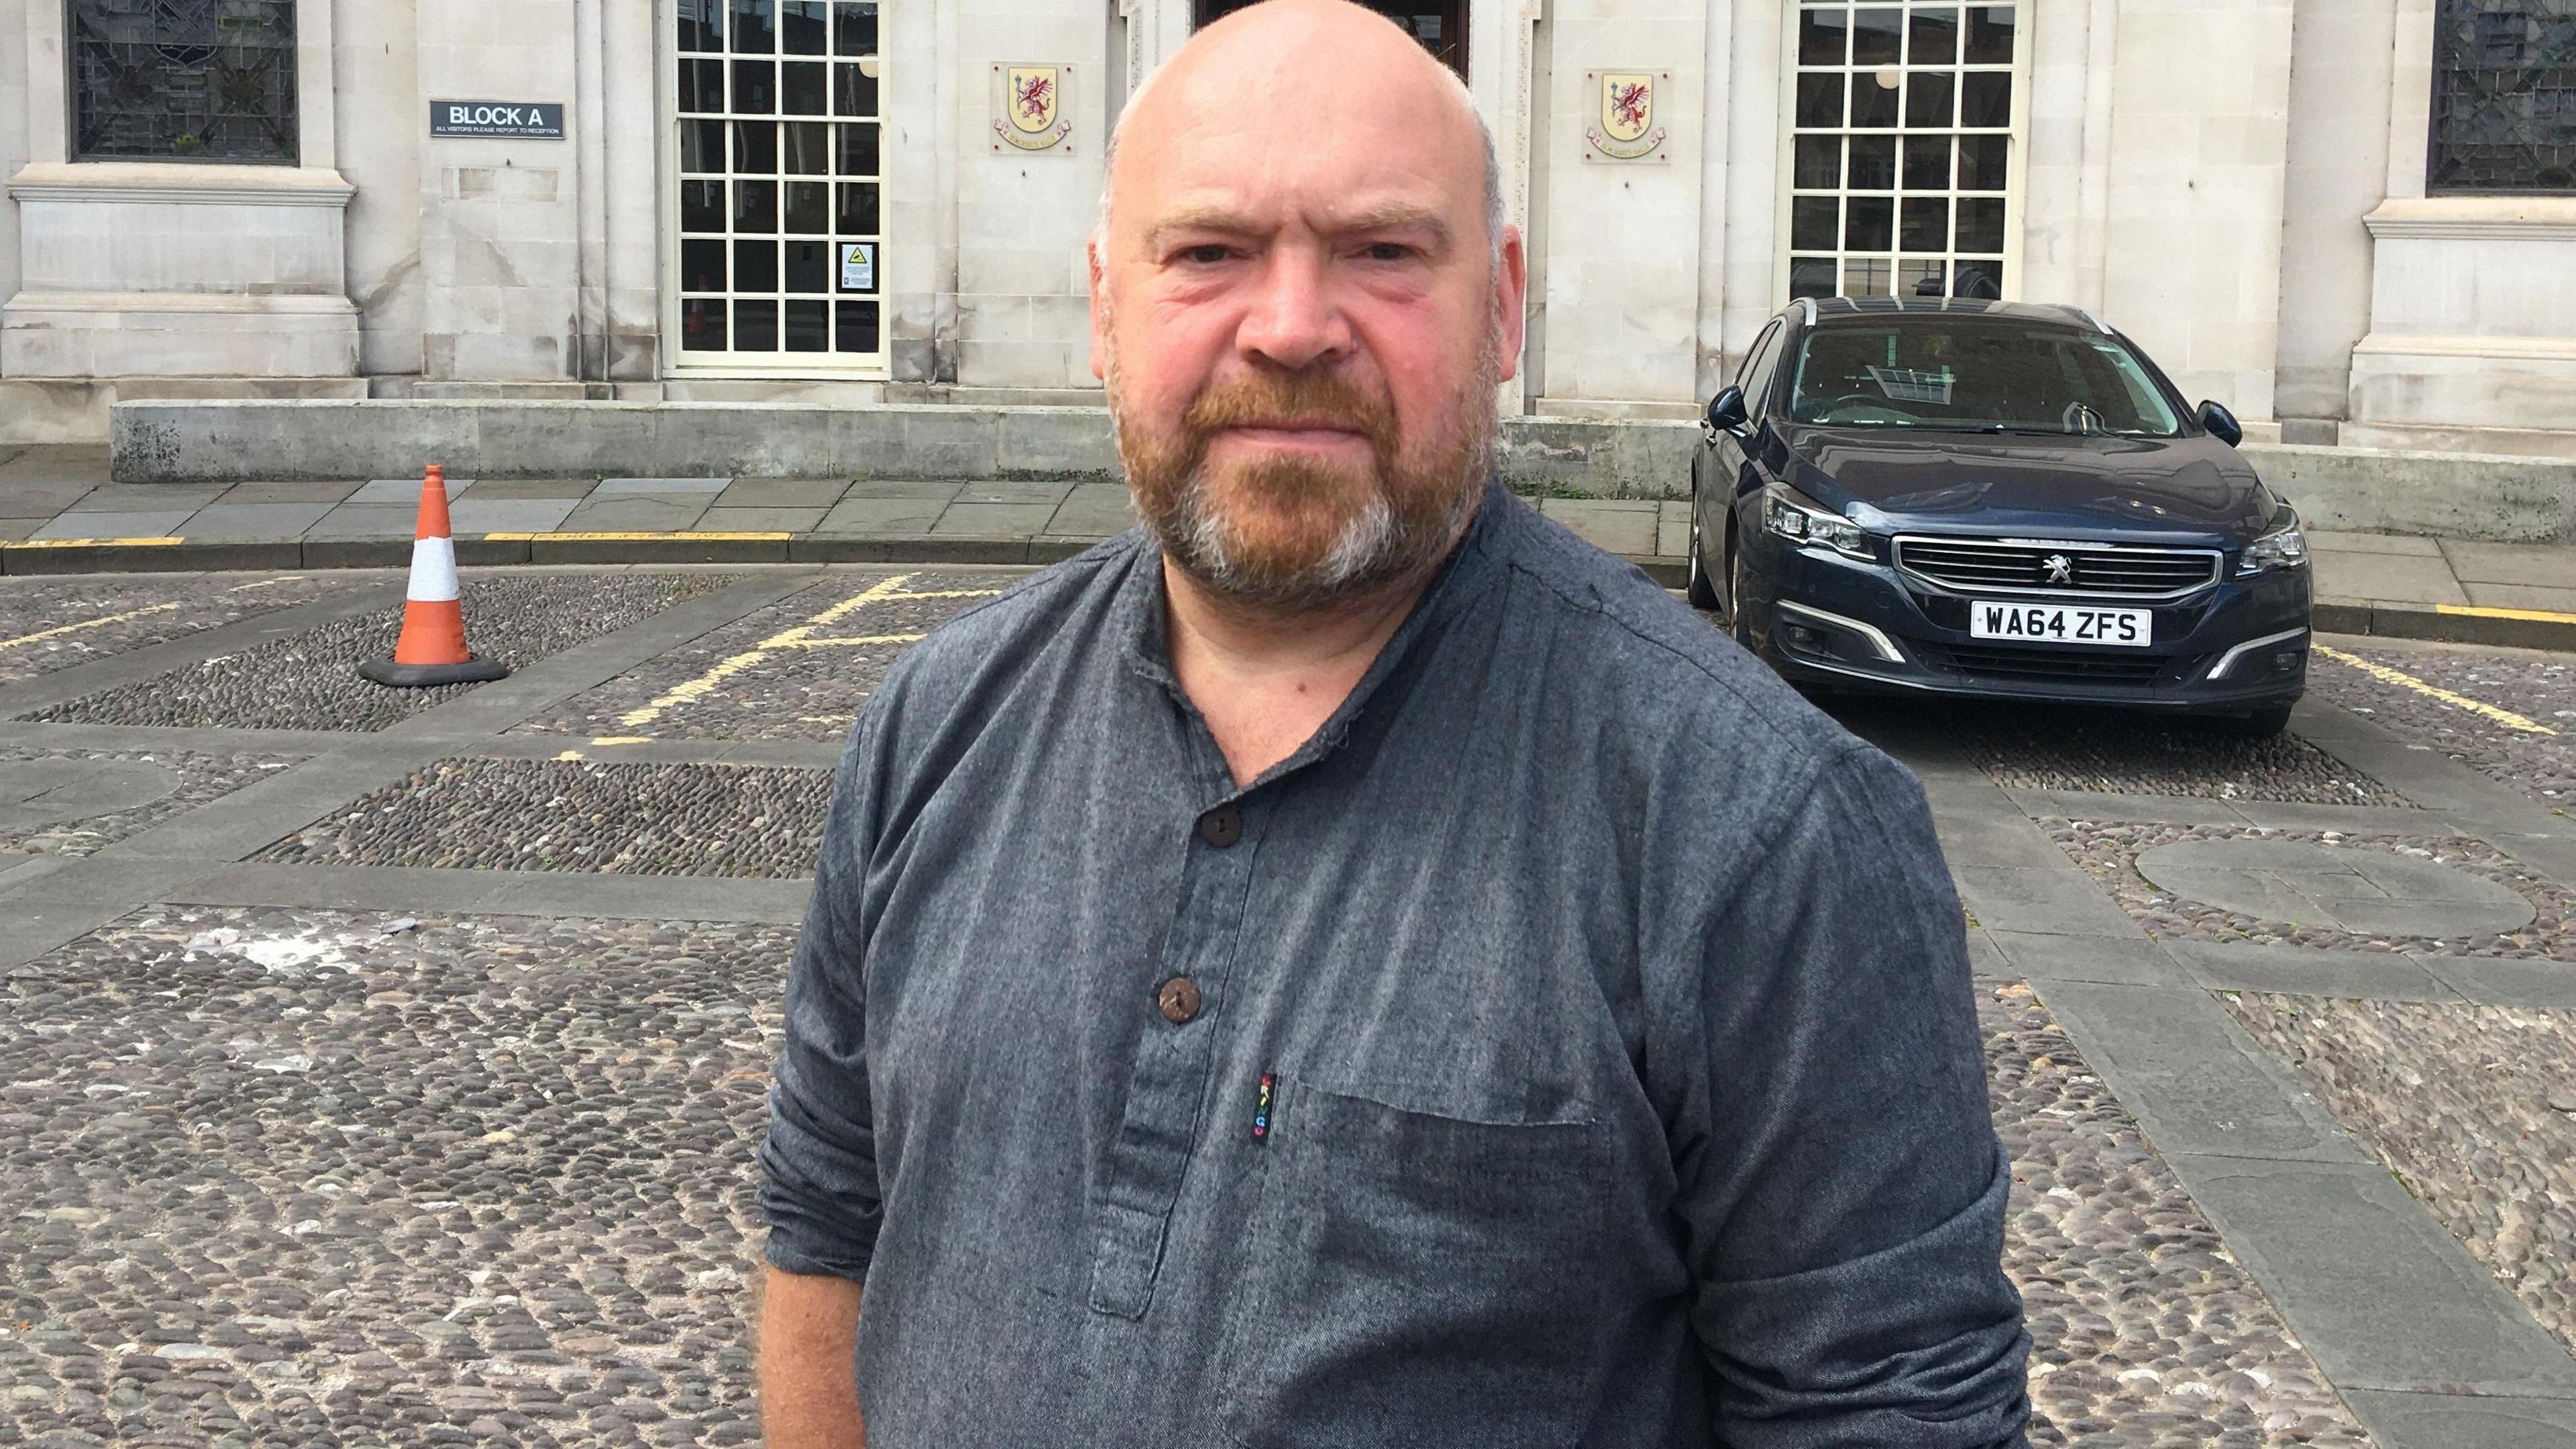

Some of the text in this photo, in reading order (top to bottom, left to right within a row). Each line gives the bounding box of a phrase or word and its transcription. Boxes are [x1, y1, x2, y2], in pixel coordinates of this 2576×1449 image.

[449, 106, 543, 125] BLOCK A
[1986, 606, 2137, 641] WA64 ZFS
